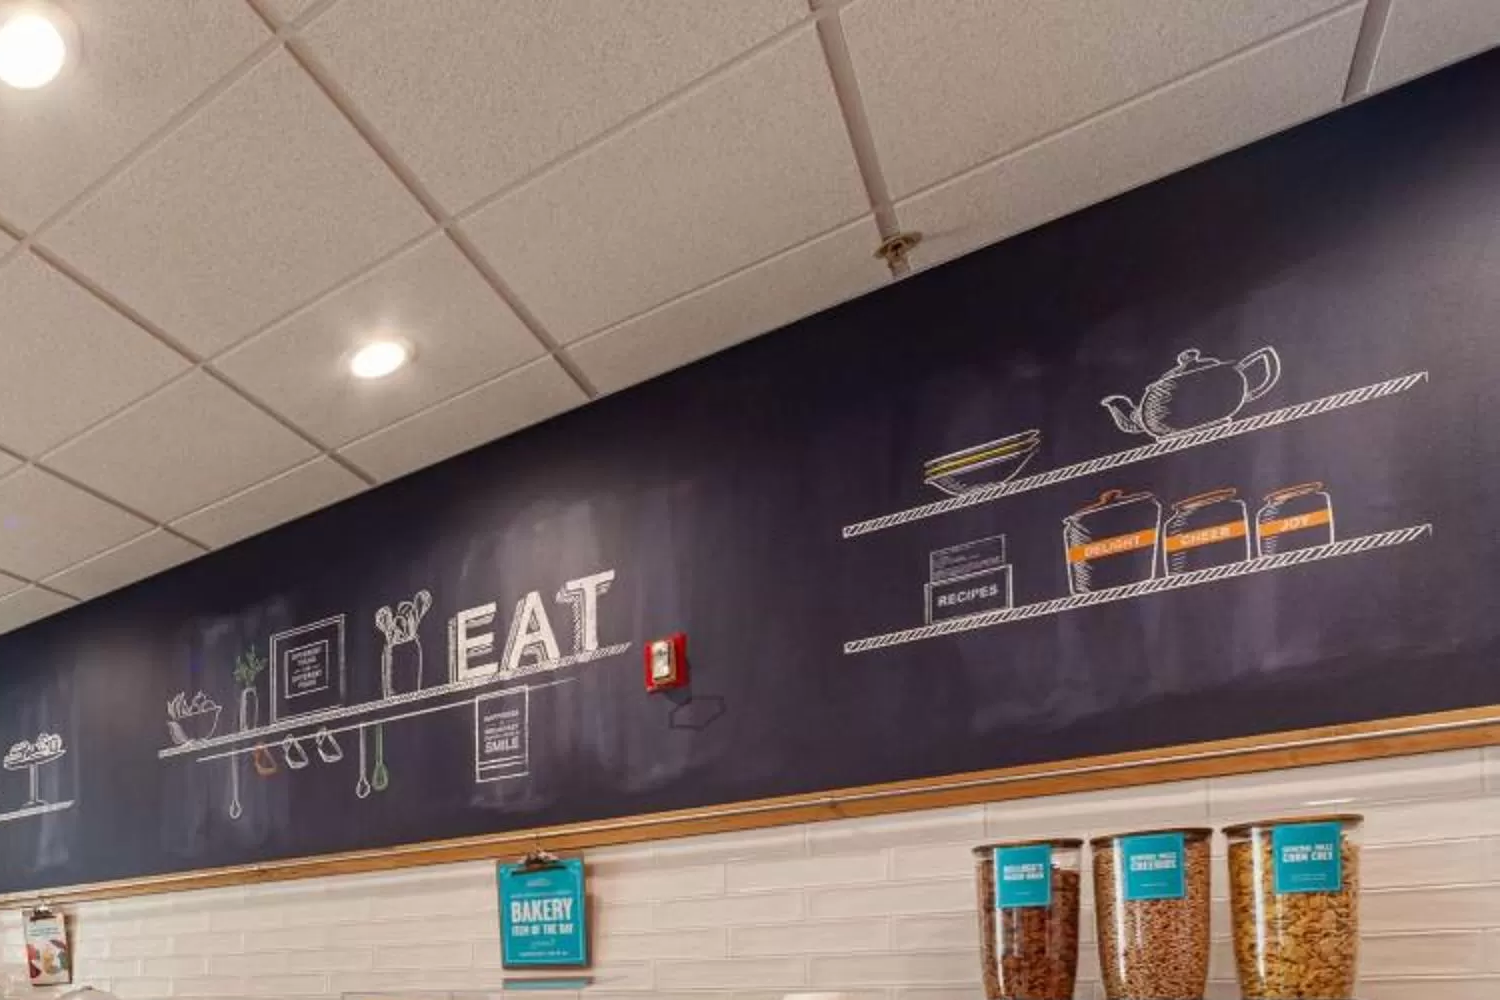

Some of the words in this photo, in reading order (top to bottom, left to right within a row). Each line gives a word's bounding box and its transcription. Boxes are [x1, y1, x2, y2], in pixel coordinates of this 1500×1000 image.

[1282, 516, 1311, 532] JOY
[1084, 535, 1141, 557] DELIGHT
[1179, 527, 1231, 545] CHEER
[937, 584, 998, 607] RECIPES
[448, 569, 616, 683] EAT
[484, 736, 519, 753] SMILE
[511, 897, 573, 923] BAKERY
[512, 925, 530, 936] ITEM
[531, 924, 541, 935] OF
[543, 924, 557, 935] THE
[559, 923, 573, 934] DAY
